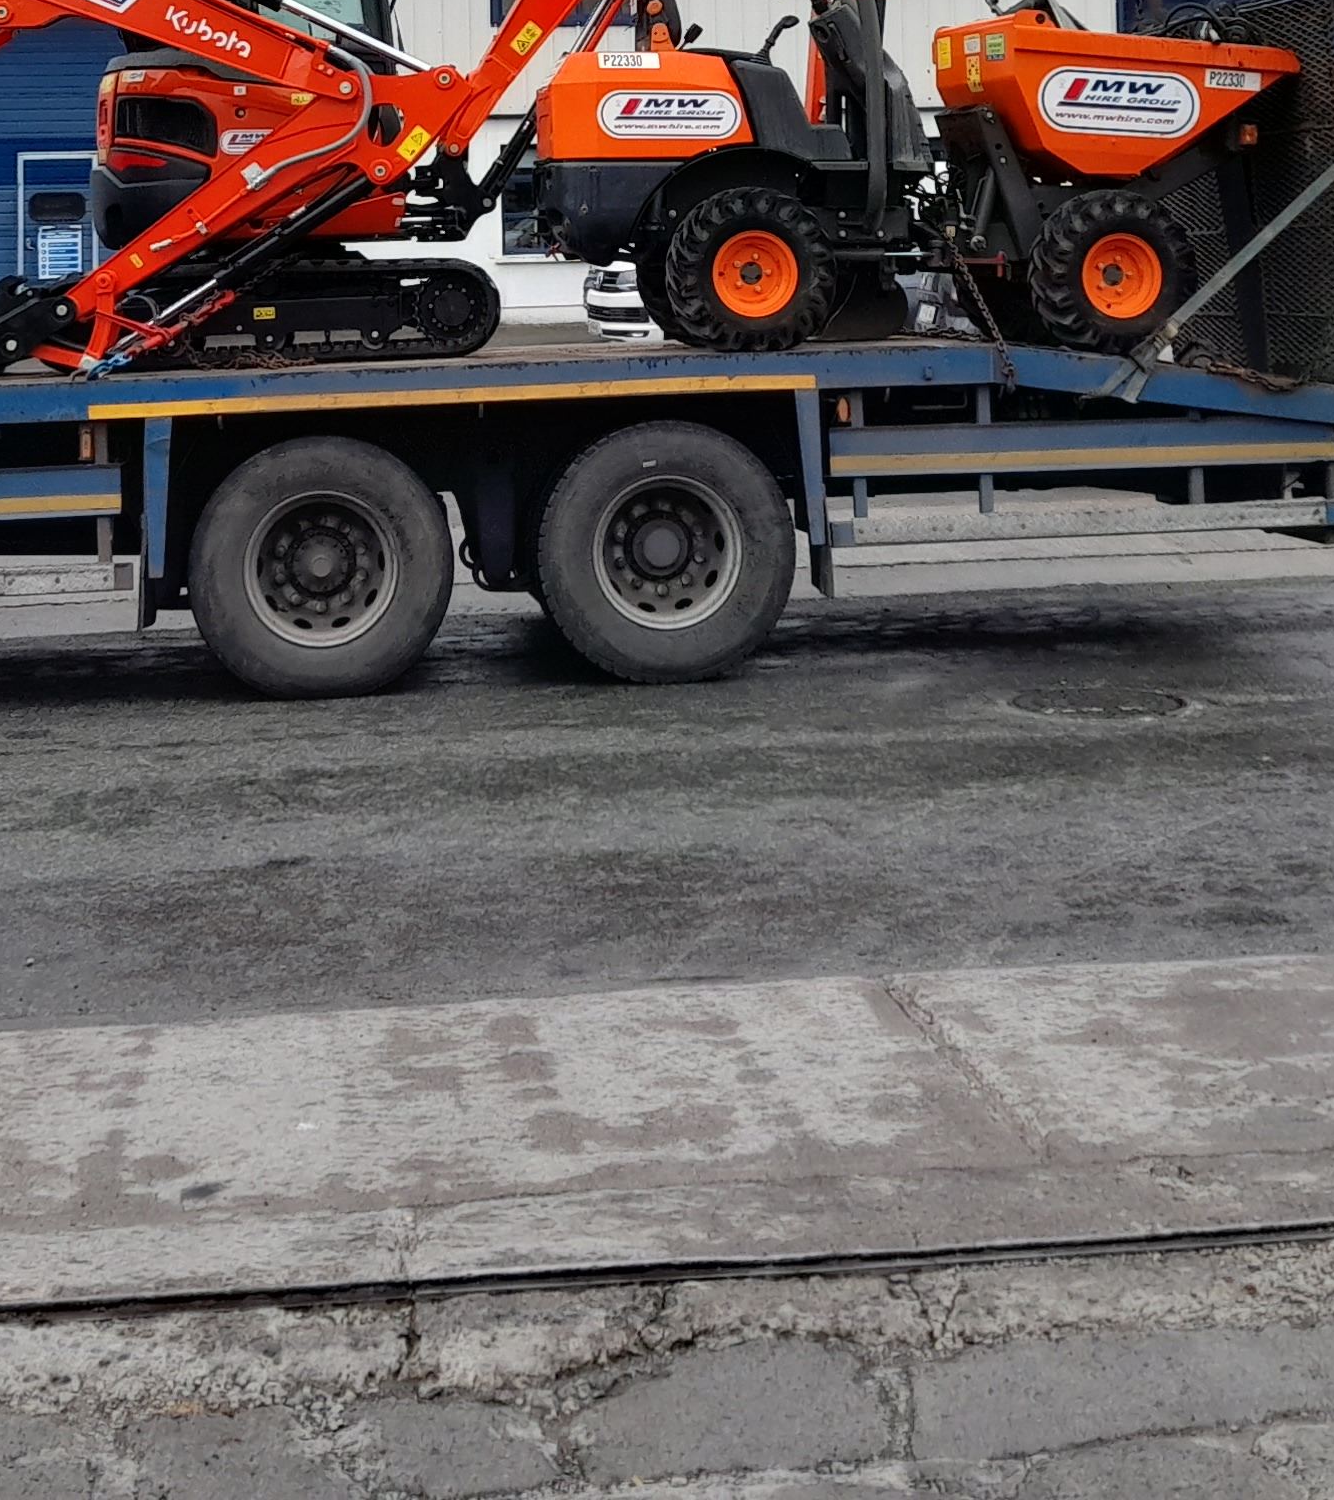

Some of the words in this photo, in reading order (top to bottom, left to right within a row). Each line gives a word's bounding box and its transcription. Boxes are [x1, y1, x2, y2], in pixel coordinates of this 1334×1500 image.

[164, 5, 252, 58] Kubota
[603, 54, 643, 67] P22330
[1209, 71, 1245, 88] P22330
[1090, 79, 1166, 96] MW
[643, 98, 710, 108] MW
[1084, 94, 1123, 103] HIRE
[1126, 97, 1182, 107] GROUP
[1055, 111, 1175, 126] www.mwhire.com
